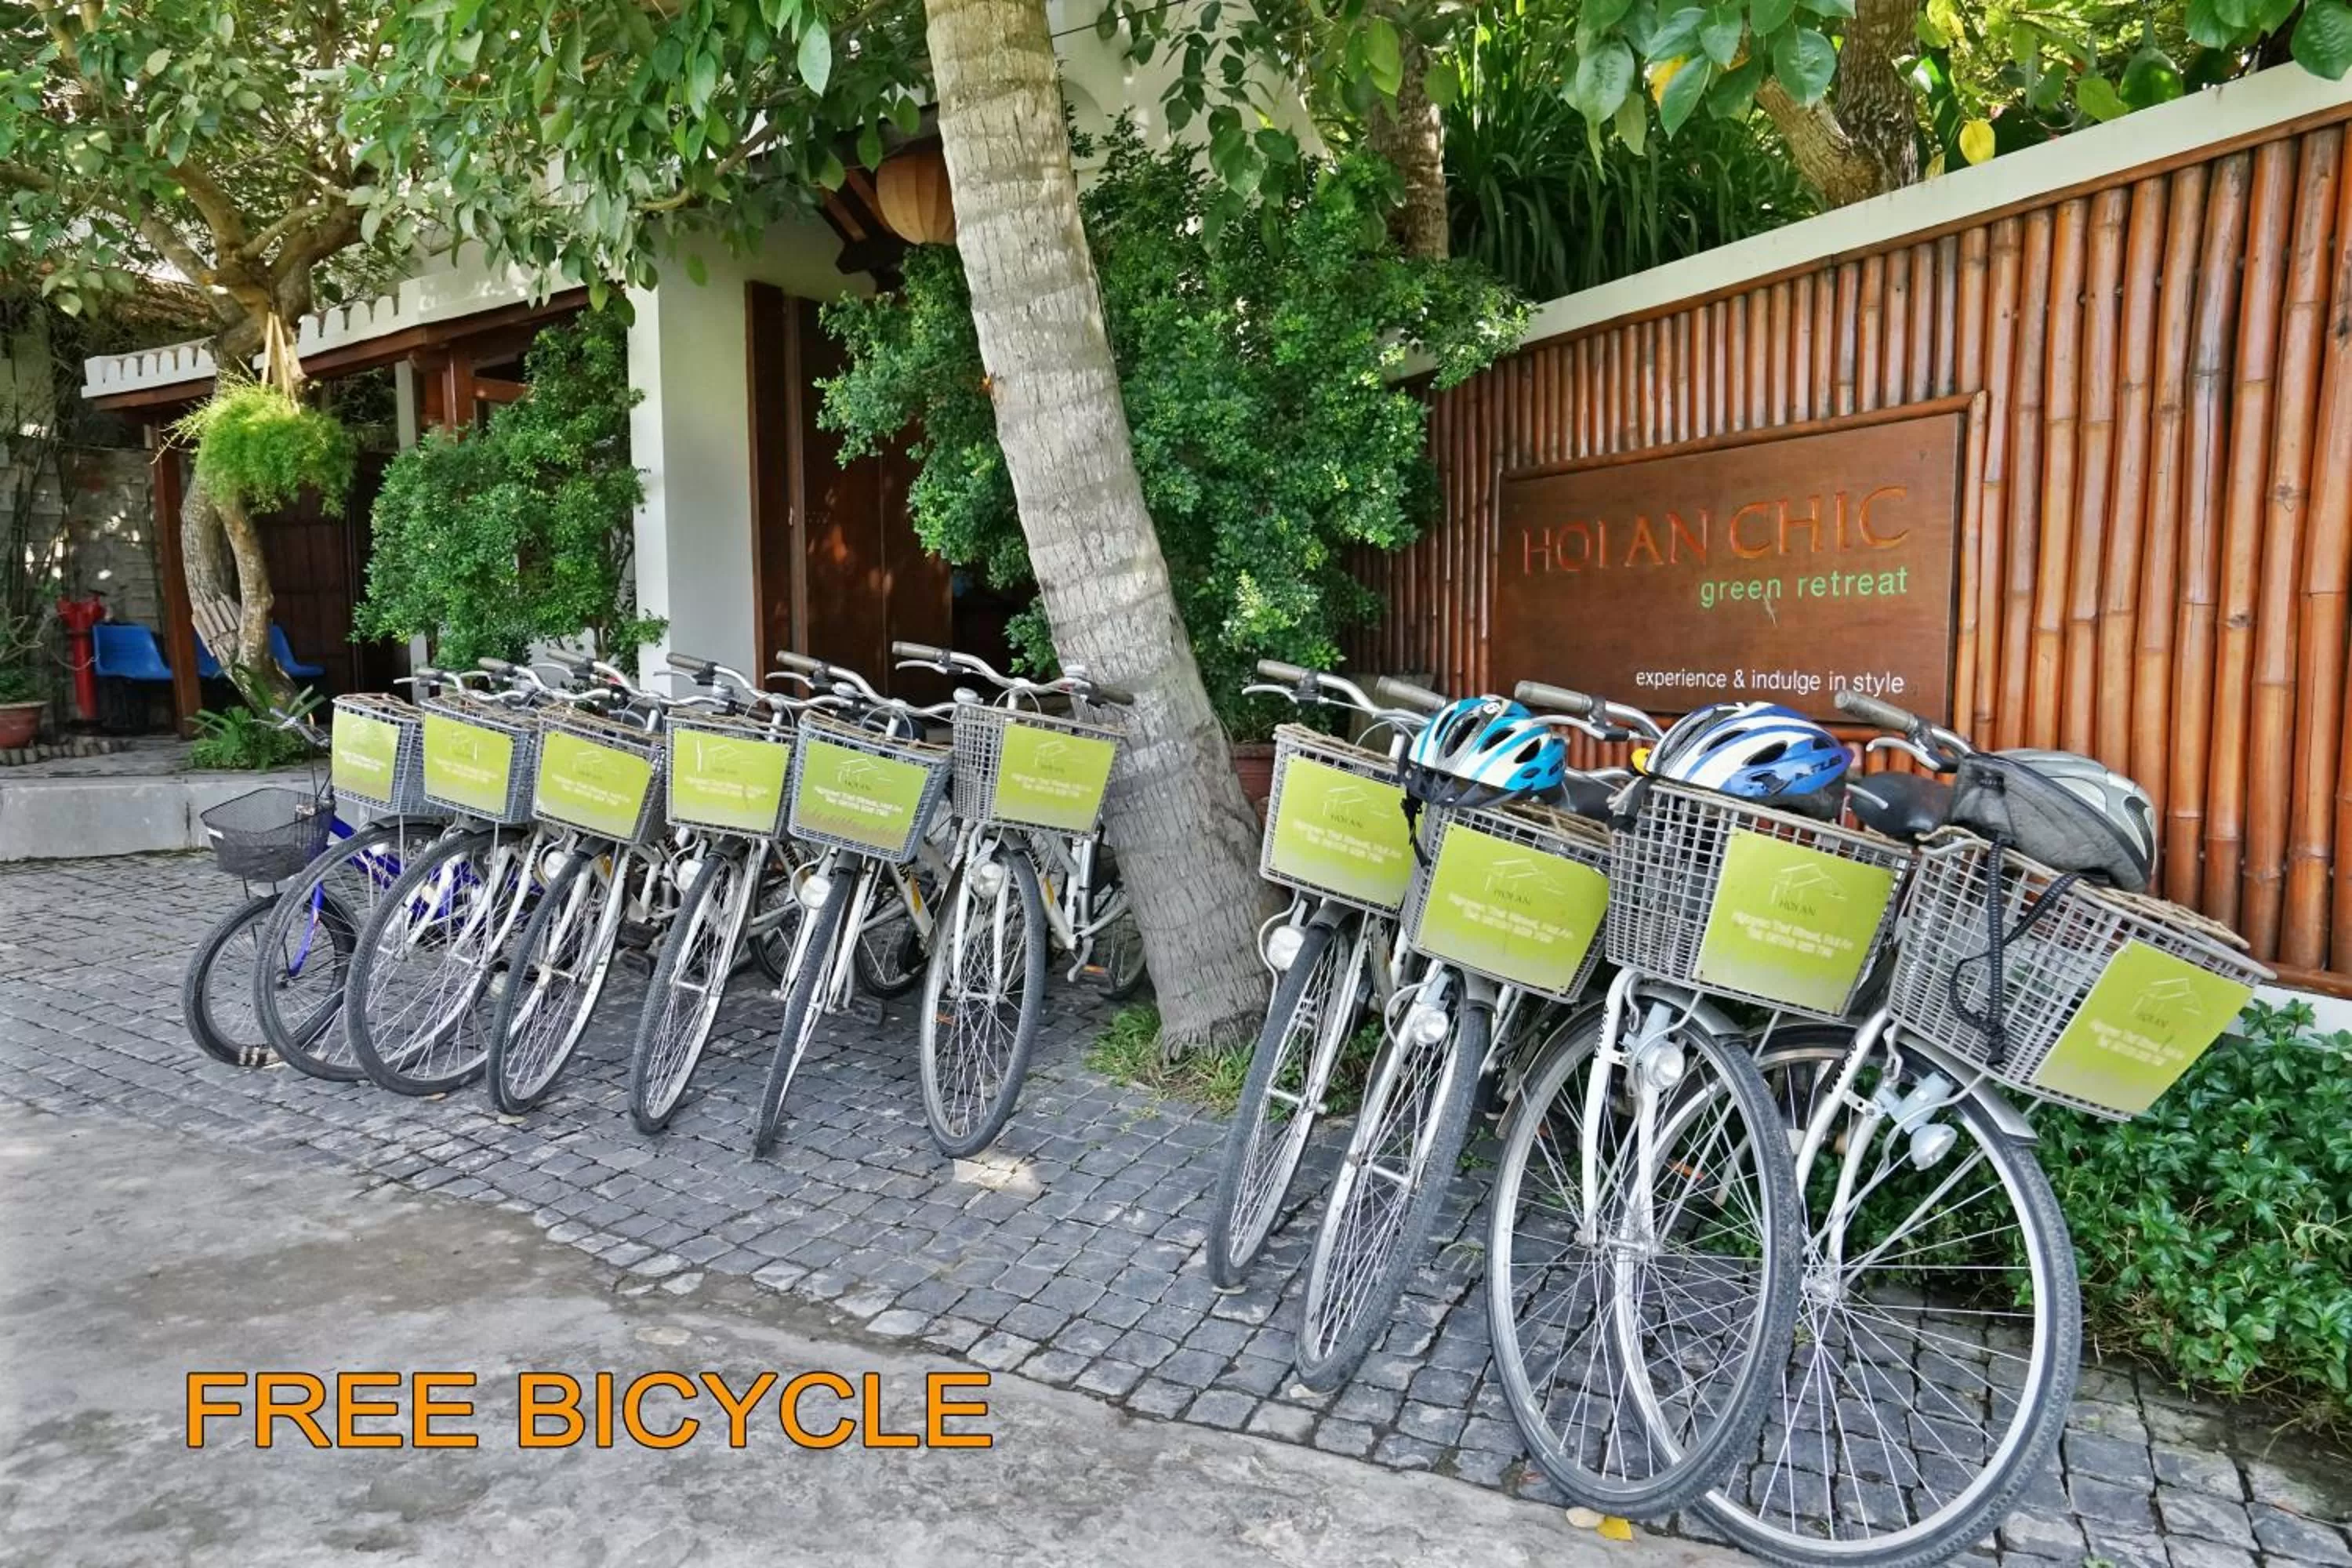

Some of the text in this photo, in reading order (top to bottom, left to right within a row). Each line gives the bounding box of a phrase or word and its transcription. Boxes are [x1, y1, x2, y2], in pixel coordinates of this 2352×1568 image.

[1521, 485, 1910, 577] HOI AN CHIC
[1700, 565, 1907, 608] green retreat
[1635, 668, 1905, 697] experience & indulge in style
